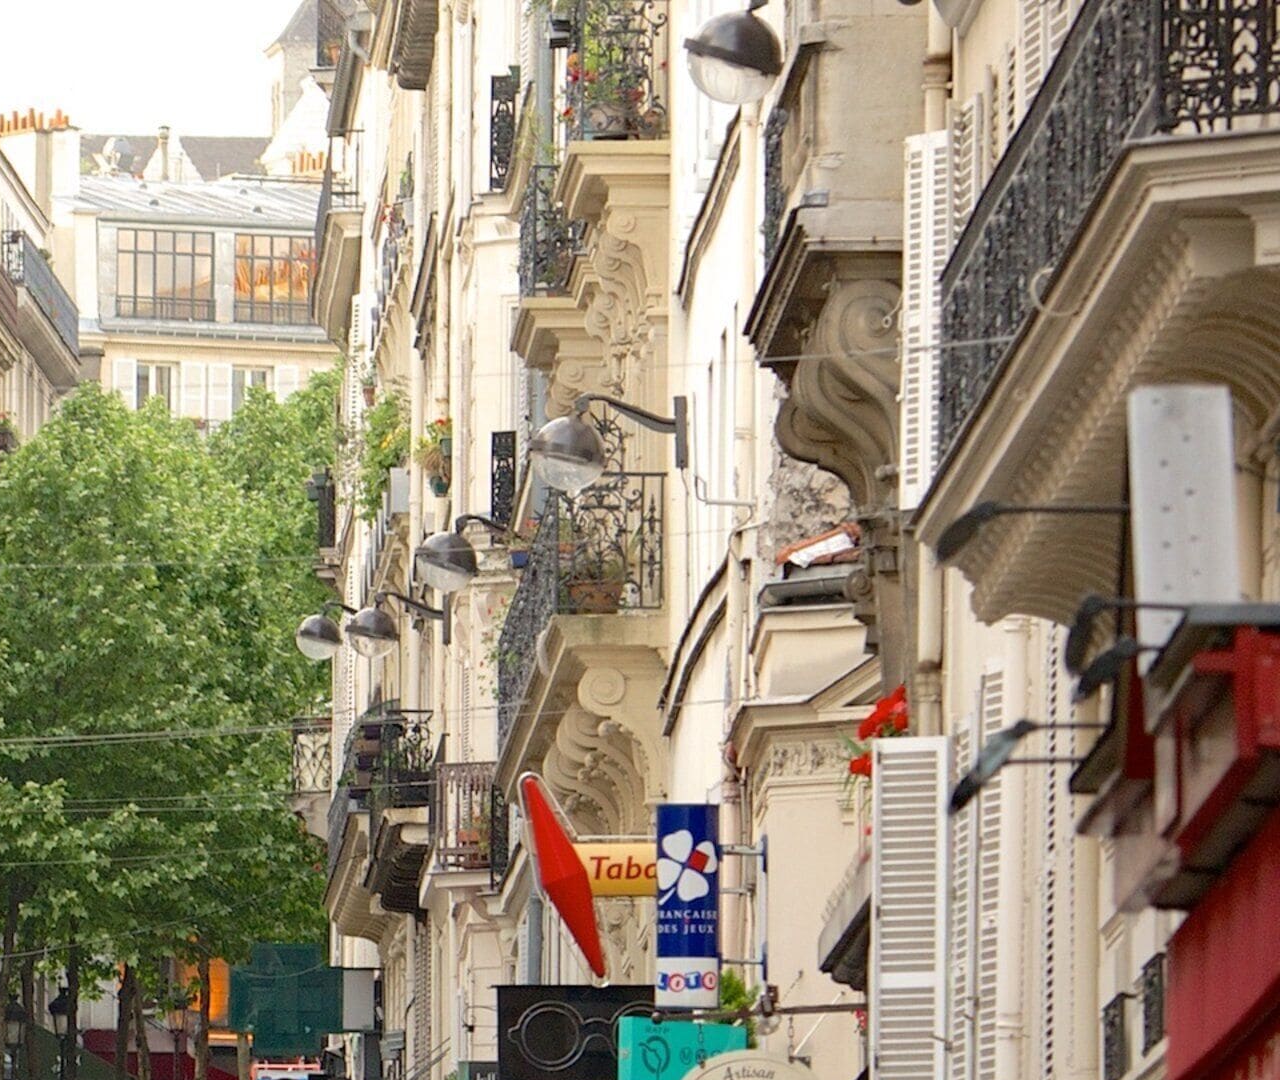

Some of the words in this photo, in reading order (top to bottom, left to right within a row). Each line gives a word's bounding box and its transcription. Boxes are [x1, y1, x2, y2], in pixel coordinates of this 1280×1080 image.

[658, 925, 678, 934] DES
[683, 925, 715, 935] JEUX
[657, 971, 717, 992] LOTO
